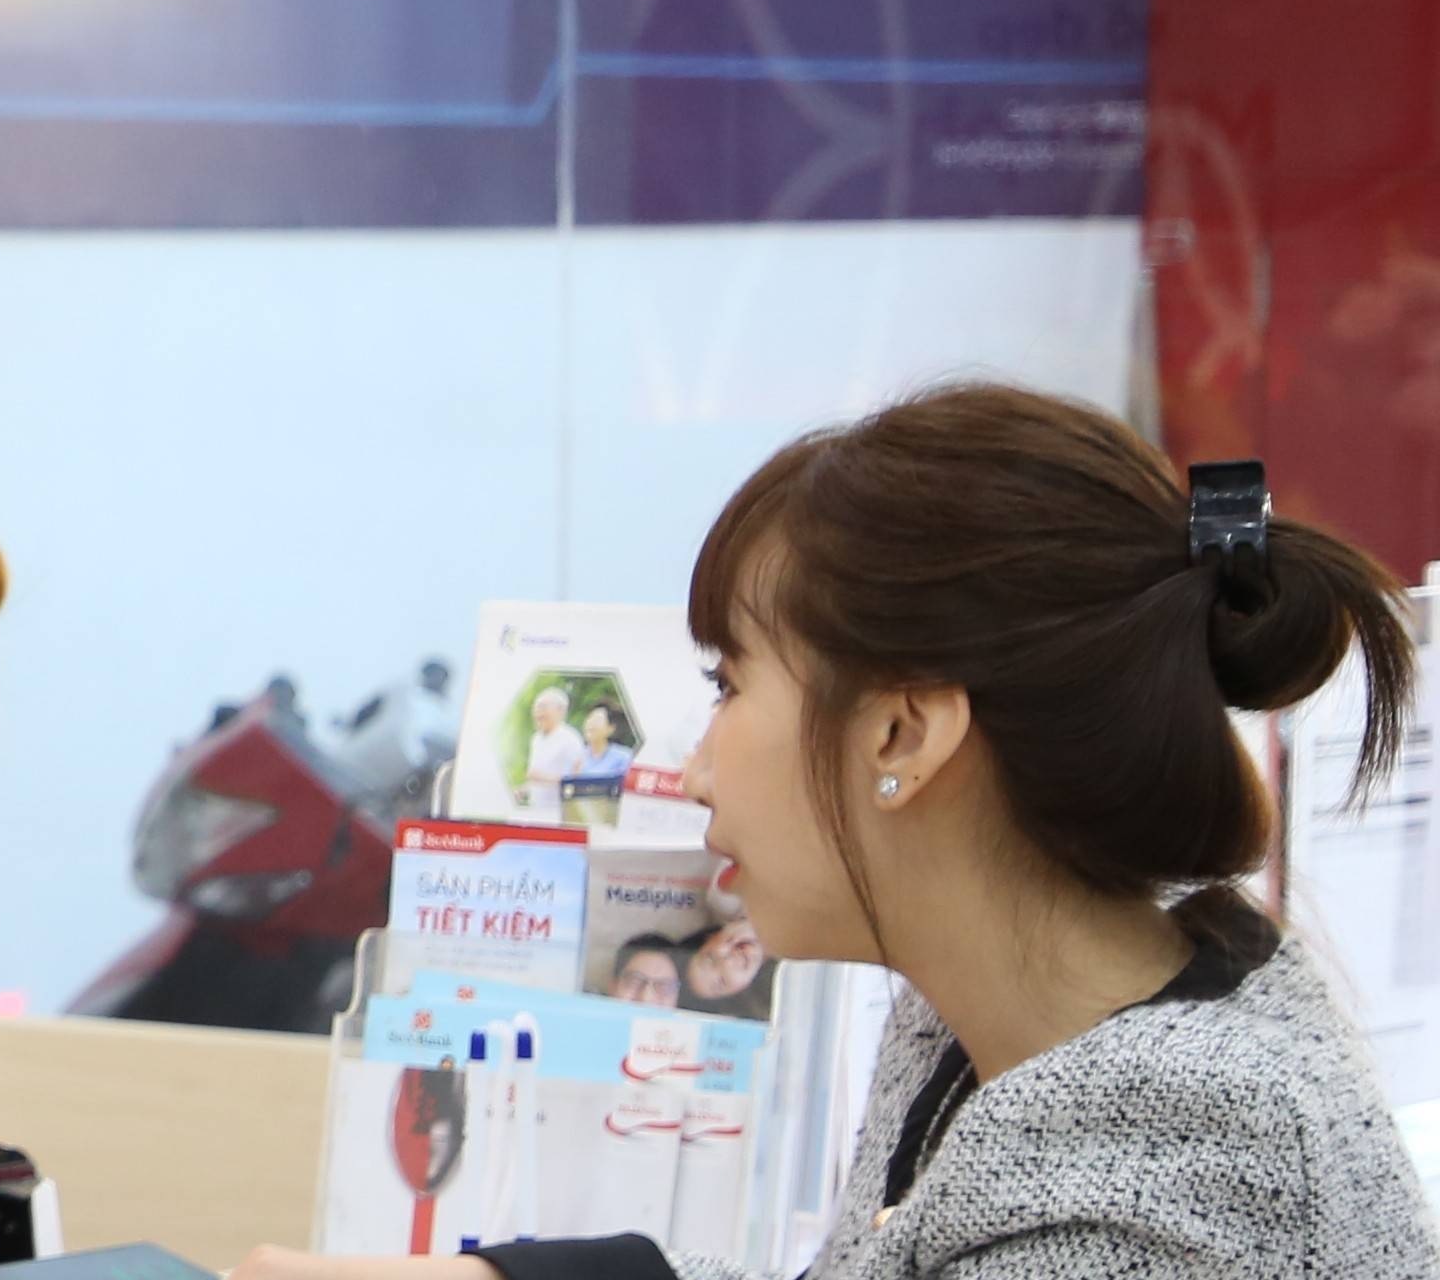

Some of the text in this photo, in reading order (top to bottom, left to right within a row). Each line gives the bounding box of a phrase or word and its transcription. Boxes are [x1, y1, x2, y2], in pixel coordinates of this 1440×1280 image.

[605, 884, 696, 908] Mediplus
[416, 901, 552, 942] TIẾT KIỆM
